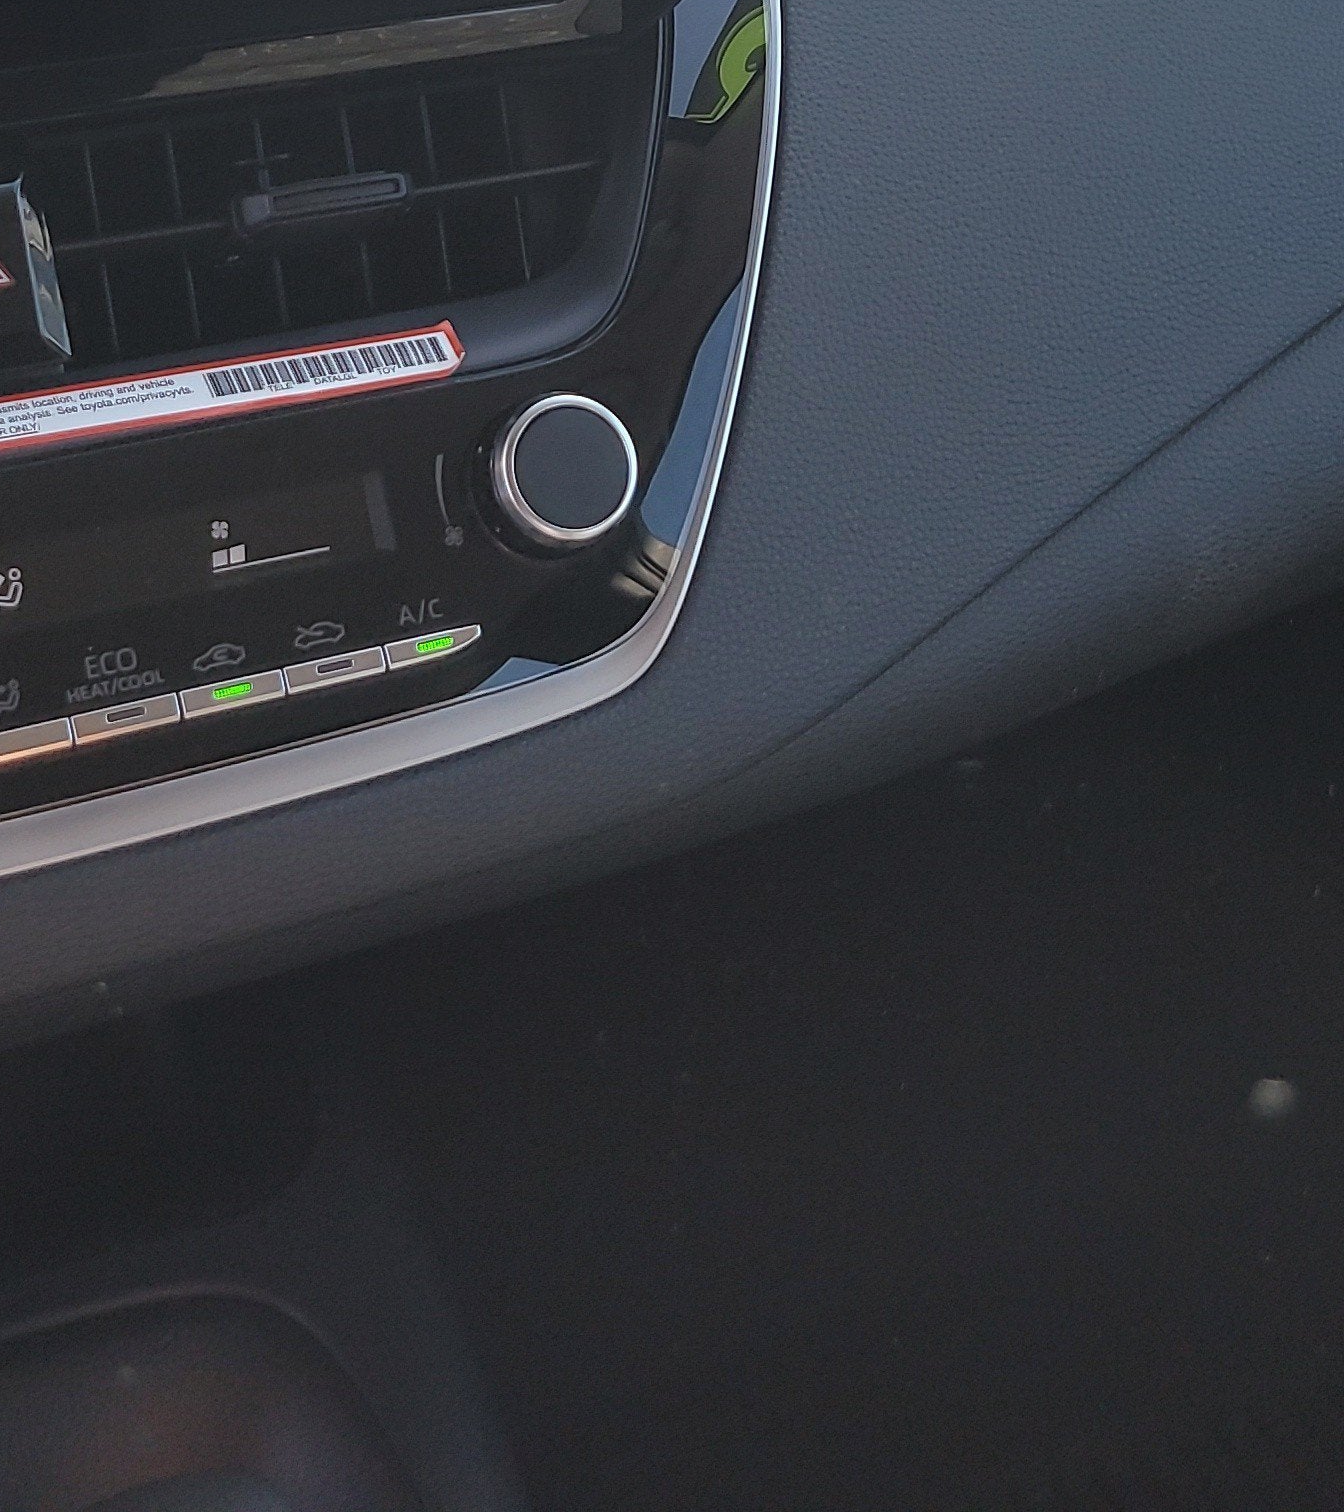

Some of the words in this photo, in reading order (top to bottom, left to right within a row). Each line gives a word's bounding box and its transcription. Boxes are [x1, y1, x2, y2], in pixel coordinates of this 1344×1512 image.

[79, 389, 114, 407] driving
[117, 385, 135, 394] and
[138, 379, 174, 390] vehicle
[57, 406, 78, 414] See
[399, 596, 443, 627] A/C
[85, 645, 138, 679] ECO
[66, 670, 166, 705] HEAT/COOL
